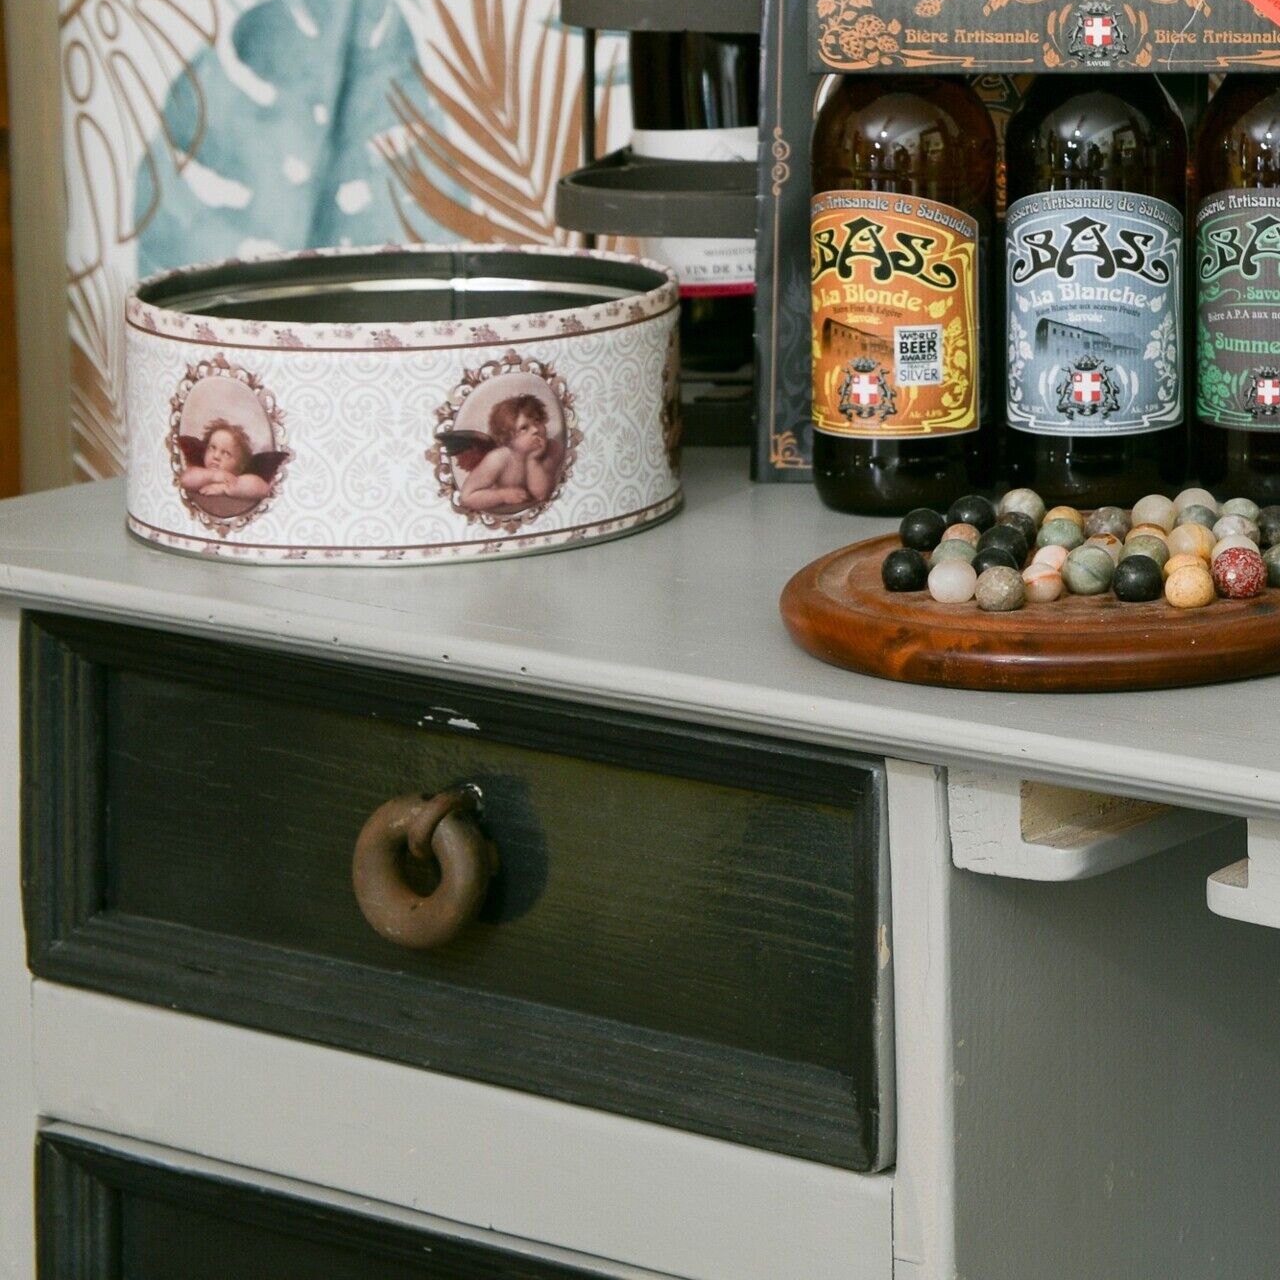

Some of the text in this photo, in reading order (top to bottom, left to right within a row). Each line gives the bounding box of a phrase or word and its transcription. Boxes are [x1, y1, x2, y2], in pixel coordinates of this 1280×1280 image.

[904, 28, 1040, 44] Bière Artisanale
[1154, 28, 1198, 44] Bière
[1085, 59, 1111, 68] SAVOIE
[826, 195, 890, 211] Artisanale
[893, 200, 913, 215] de
[1042, 196, 1114, 212] Artisanale
[1117, 198, 1136, 212] de
[811, 215, 960, 293] BAS
[1011, 215, 1171, 288] BAS
[820, 283, 924, 312] La Blonde
[1030, 283, 1149, 309] La Blanche
[1251, 312, 1269, 320] aux
[898, 331, 938, 341] WORLD
[898, 340, 938, 355] BEER
[899, 353, 938, 362] AWARDS
[898, 368, 940, 382] SILVER
